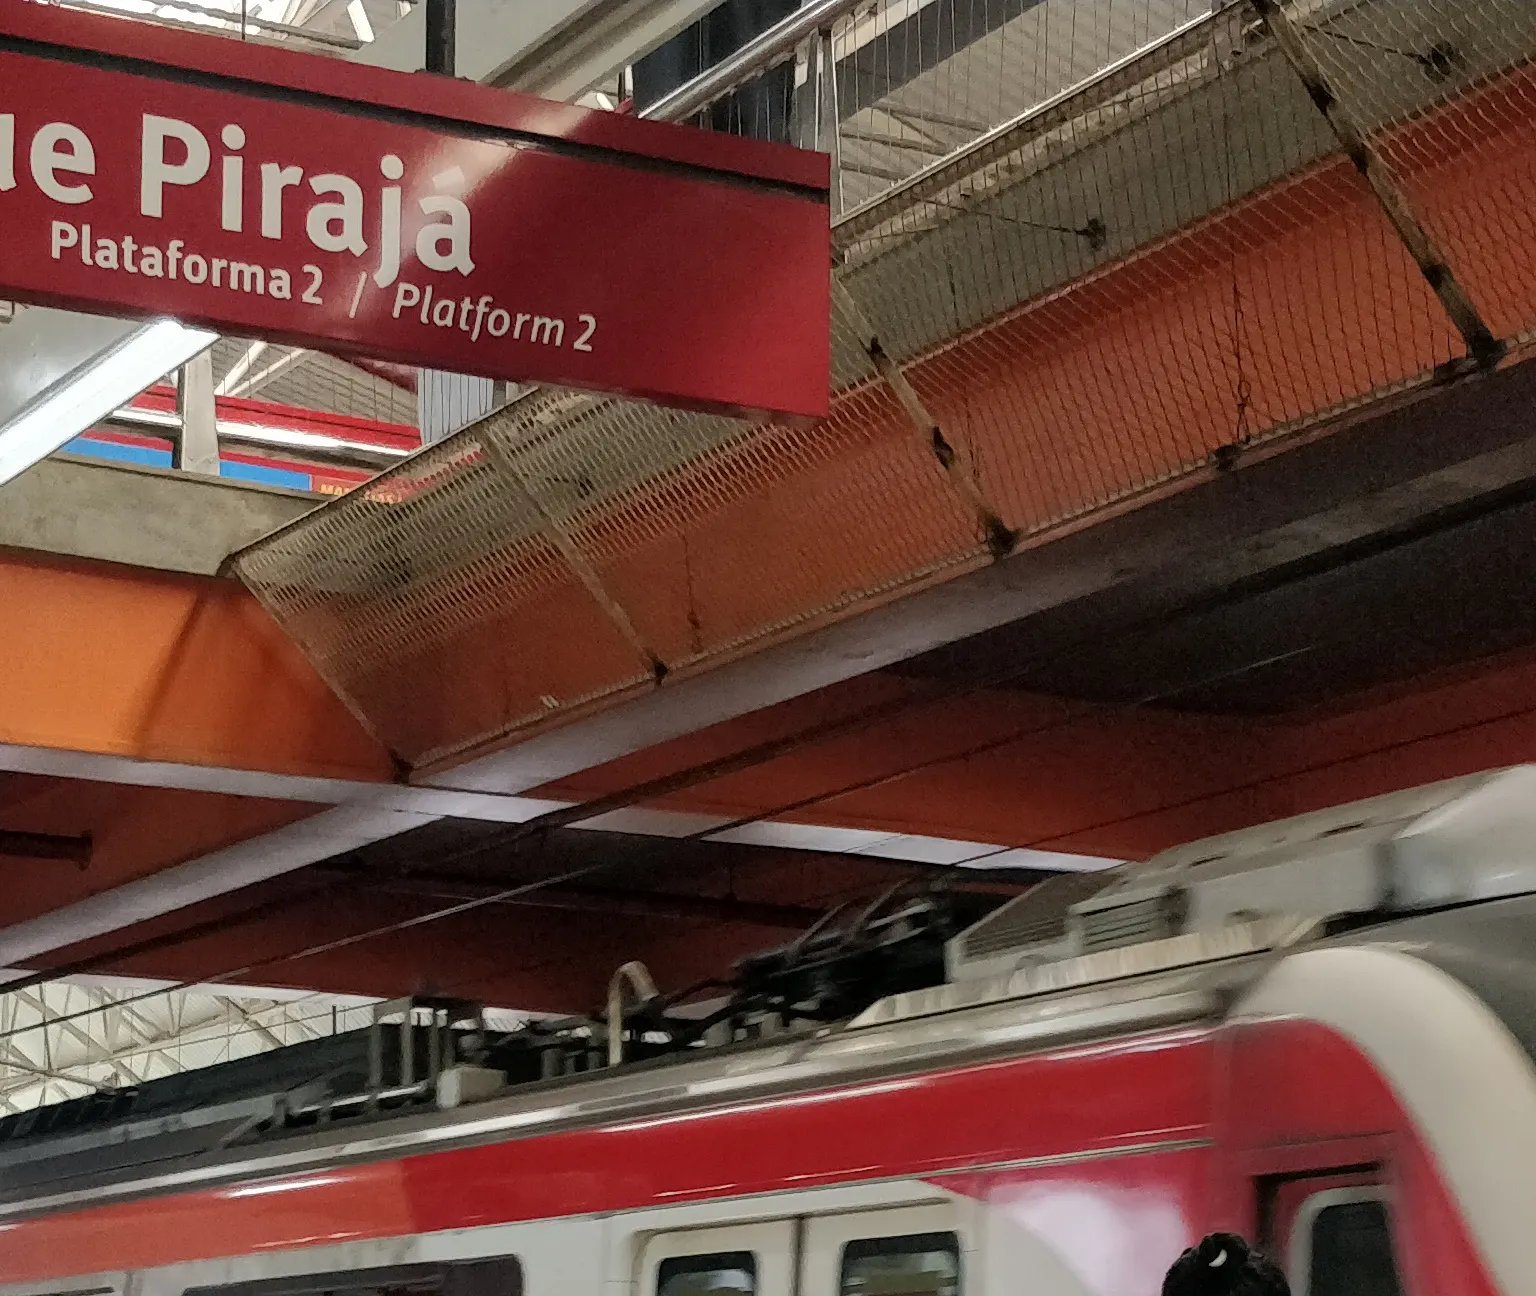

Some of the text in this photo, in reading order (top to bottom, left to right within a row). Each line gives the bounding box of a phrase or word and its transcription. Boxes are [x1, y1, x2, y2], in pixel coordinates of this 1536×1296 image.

[140, 113, 476, 288] Pirajá
[50, 220, 597, 352] Plataforma 2 / Platform 2
